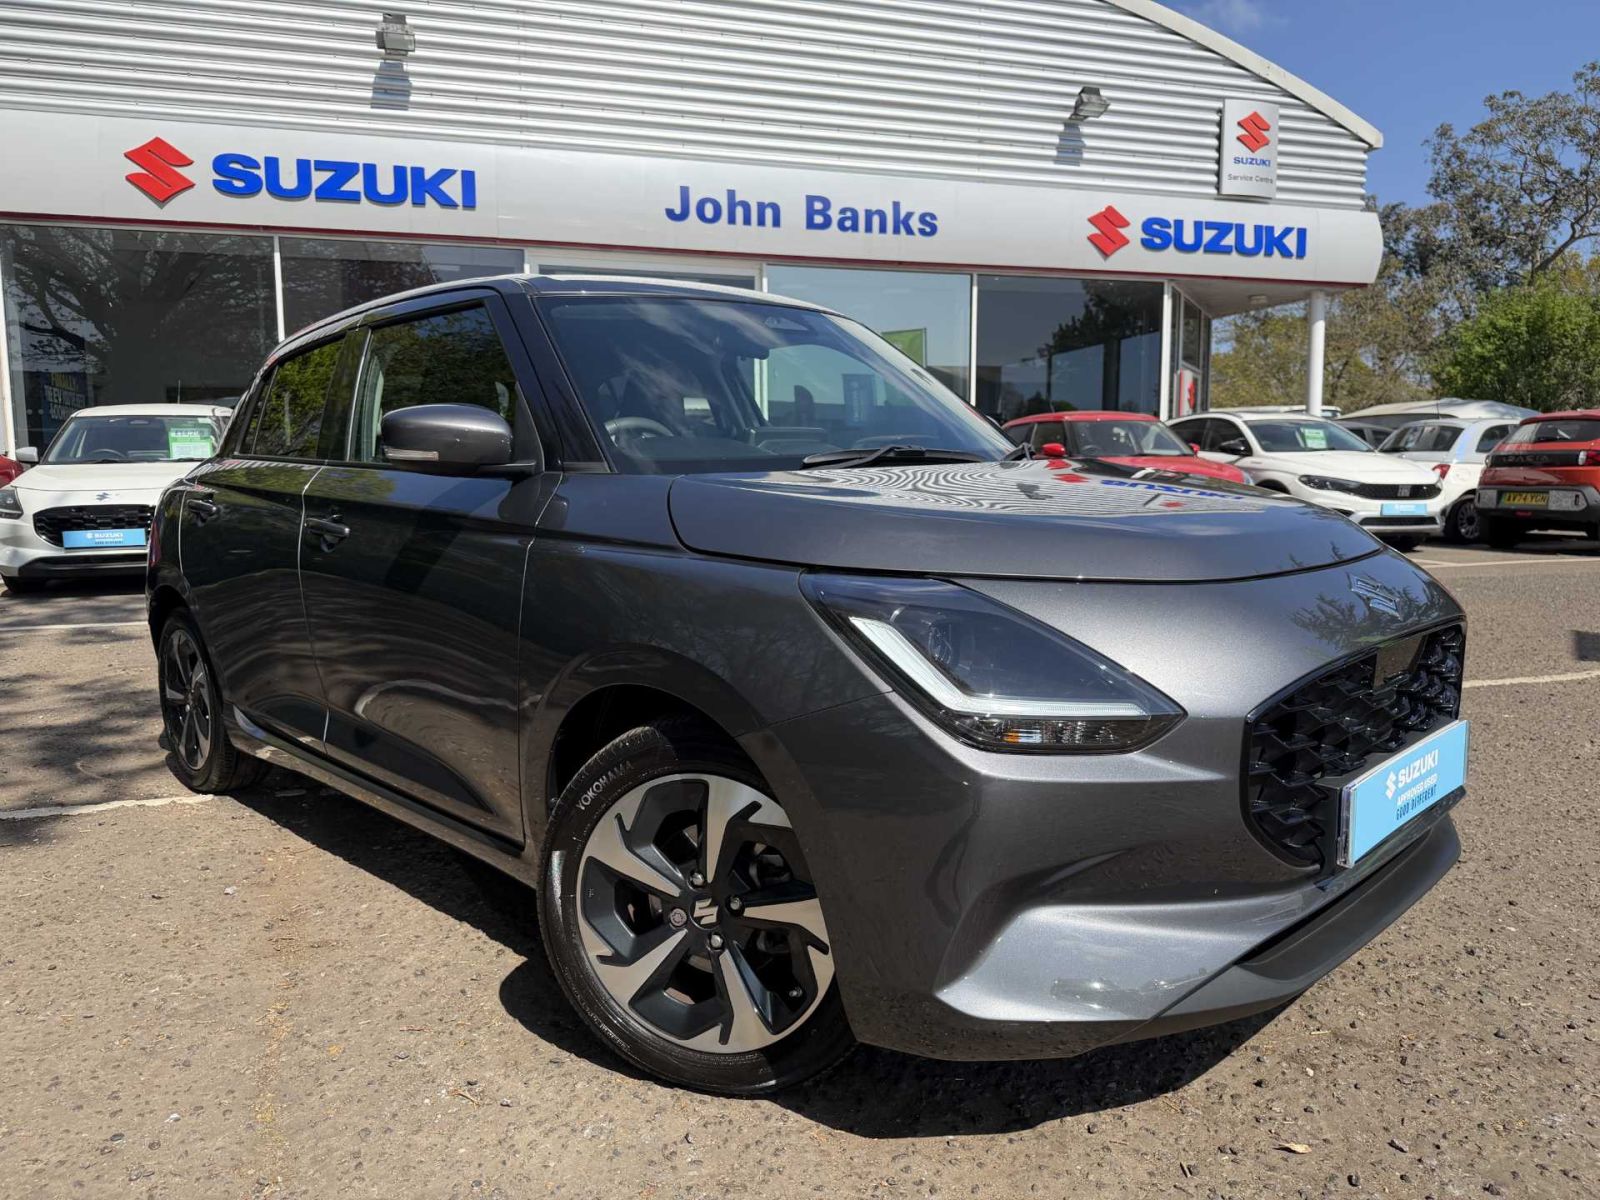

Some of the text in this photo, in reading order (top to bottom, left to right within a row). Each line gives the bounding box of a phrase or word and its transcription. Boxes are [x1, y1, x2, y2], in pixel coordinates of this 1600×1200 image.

[212, 153, 476, 209] SUZUKI
[1227, 173, 1253, 182] Service
[1233, 156, 1271, 167] SUZUKI
[665, 185, 938, 237] John Banks
[1140, 217, 1307, 259] SUZUKI
[1398, 749, 1439, 788] SUZUKI
[1396, 801, 1410, 821] GOOD
